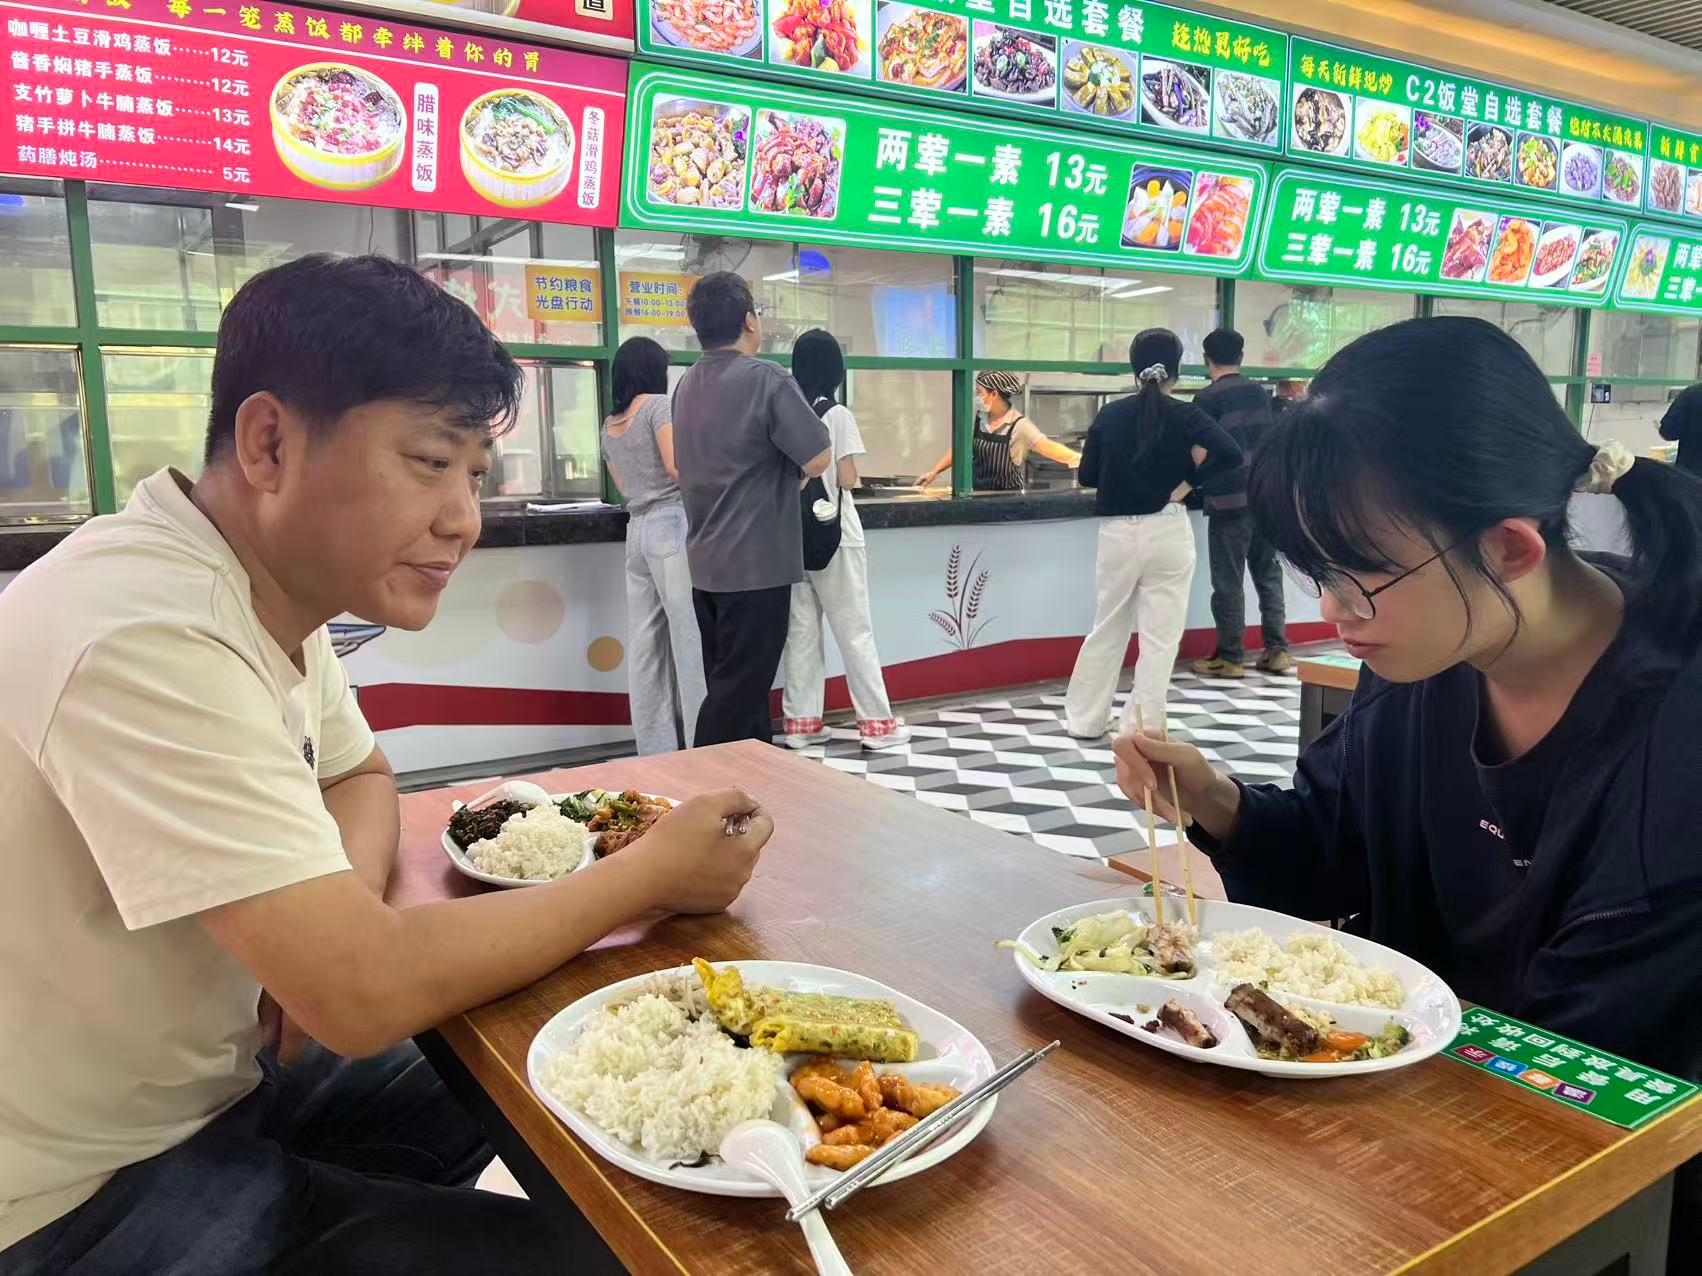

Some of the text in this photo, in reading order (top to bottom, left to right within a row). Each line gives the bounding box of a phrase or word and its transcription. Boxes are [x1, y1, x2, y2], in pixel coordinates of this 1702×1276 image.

[965, 0, 1145, 44] 自选套餐
[11, 51, 249, 97] 酱香焖猪手蒸饭 12元
[211, 47, 249, 67] 12元
[1301, 54, 1393, 96] 每天新鲜现炒
[13, 83, 250, 126] 支竹萝卜牛腩蒸饭 13元
[16, 114, 250, 156] 猪手拼牛腩蒸饭 14元
[415, 93, 436, 183] 腊味蒸饭
[18, 145, 250, 183] 药膳炖汤 5元
[581, 110, 599, 206] 冬菇滑鸡蒸饭
[875, 127, 1108, 195] 两荤一素 13元
[868, 185, 1100, 244] 三荤一素 16元
[1292, 188, 1441, 236] 两荤一素 13元
[1282, 232, 1432, 275] 三荤一素 16元
[535, 276, 592, 293] 节约粮食
[535, 296, 593, 312] 光盘行动
[1471, 1013, 1678, 1095] 餐具放到回收处
